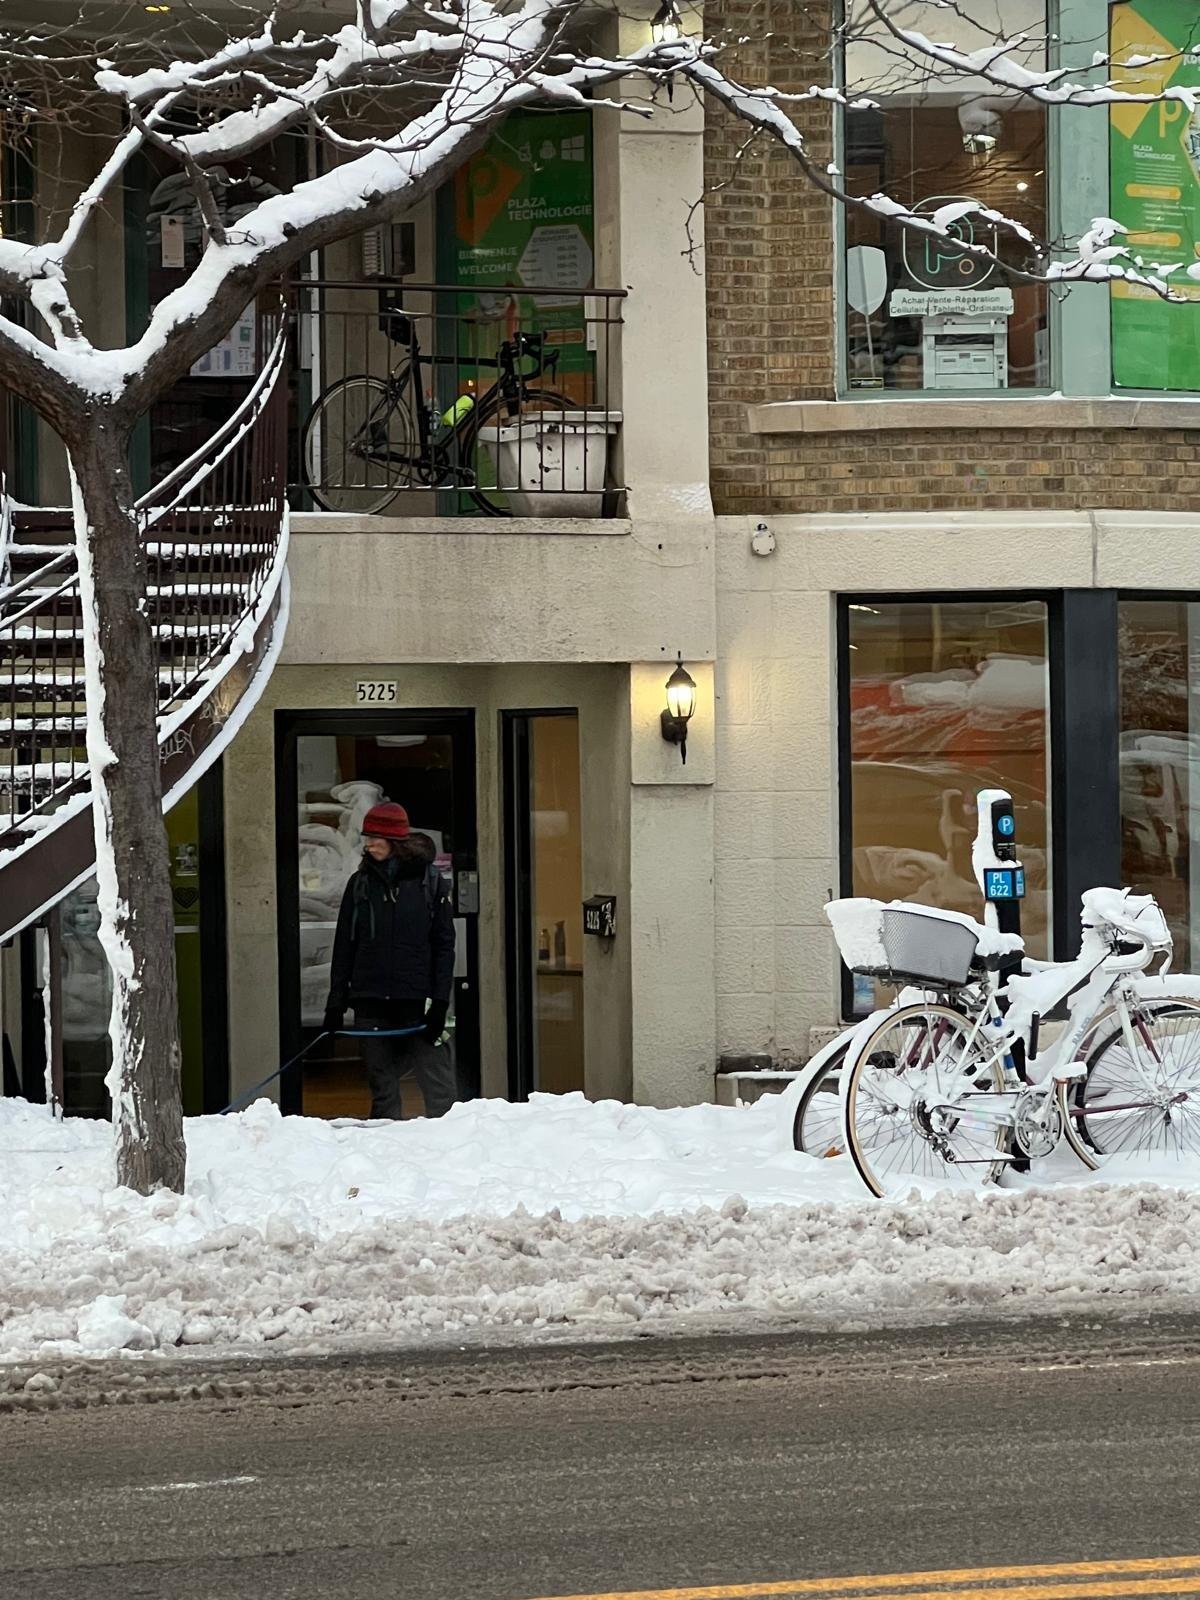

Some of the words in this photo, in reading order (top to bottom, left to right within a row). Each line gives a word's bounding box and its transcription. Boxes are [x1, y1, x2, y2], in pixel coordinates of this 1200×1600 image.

[507, 197, 546, 209] PLAZA
[508, 204, 592, 221] TECHNOLOGIE
[458, 263, 513, 275] WELCOME
[358, 683, 395, 701] 5225
[1002, 818, 1011, 832] P
[992, 872, 1005, 884] PL
[990, 884, 1009, 896] 622
